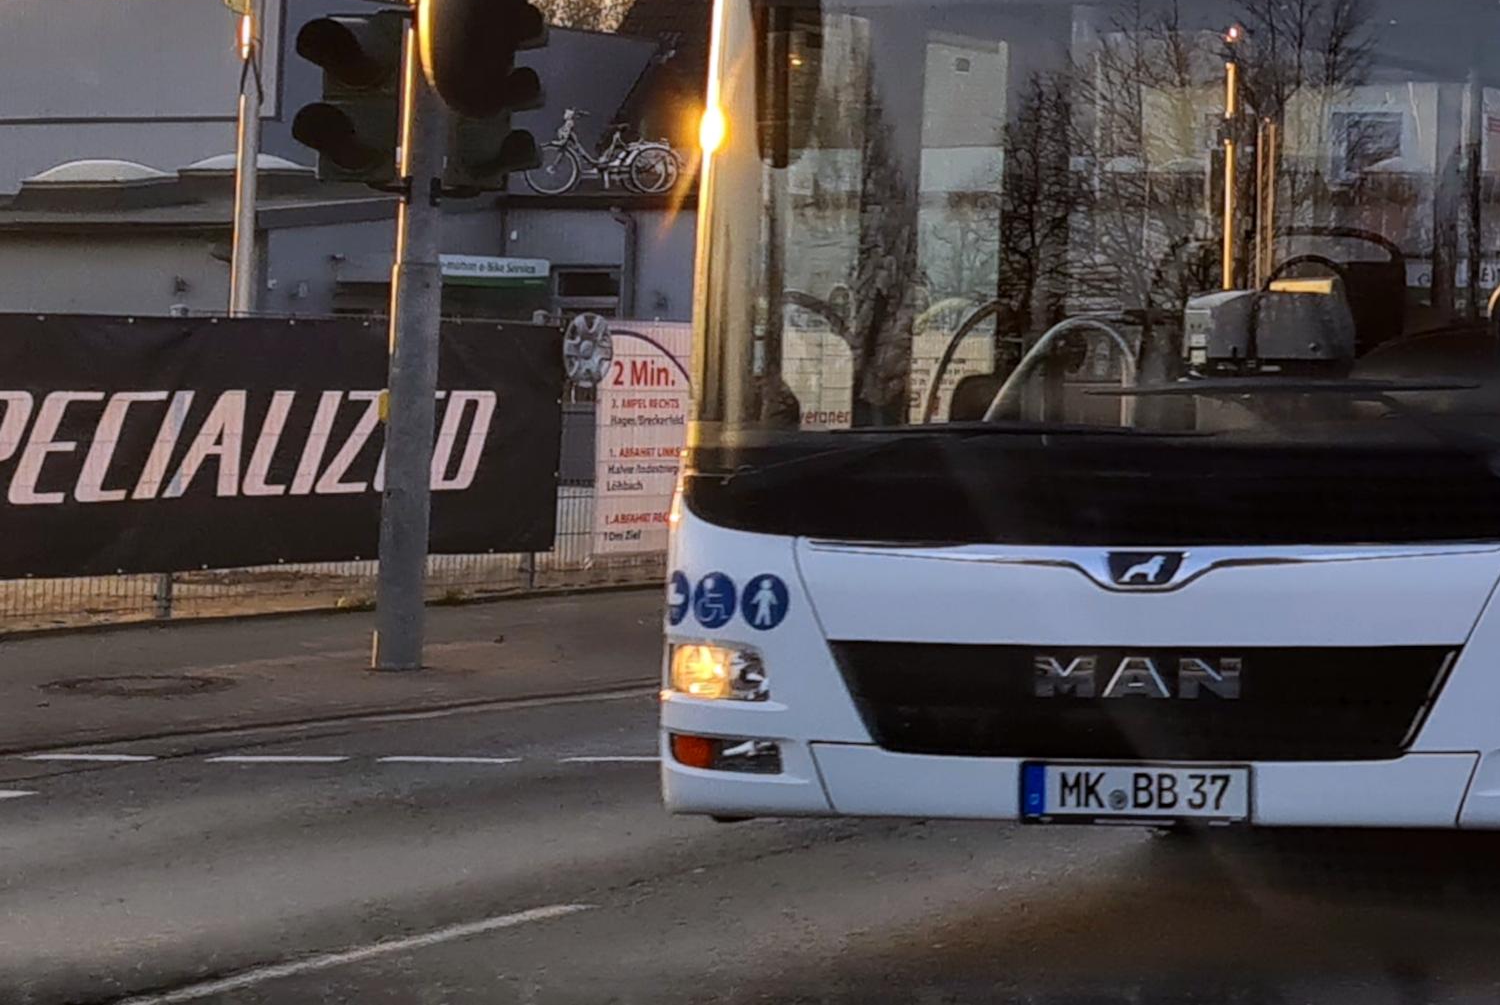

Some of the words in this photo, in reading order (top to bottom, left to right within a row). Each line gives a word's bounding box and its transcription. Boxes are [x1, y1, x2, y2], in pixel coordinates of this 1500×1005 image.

[613, 360, 624, 386] 2
[631, 359, 676, 387] Min.
[1034, 656, 1242, 699] MAN
[1059, 771, 1106, 809] MK
[1132, 773, 1178, 809] BB
[1187, 774, 1231, 810] 37
